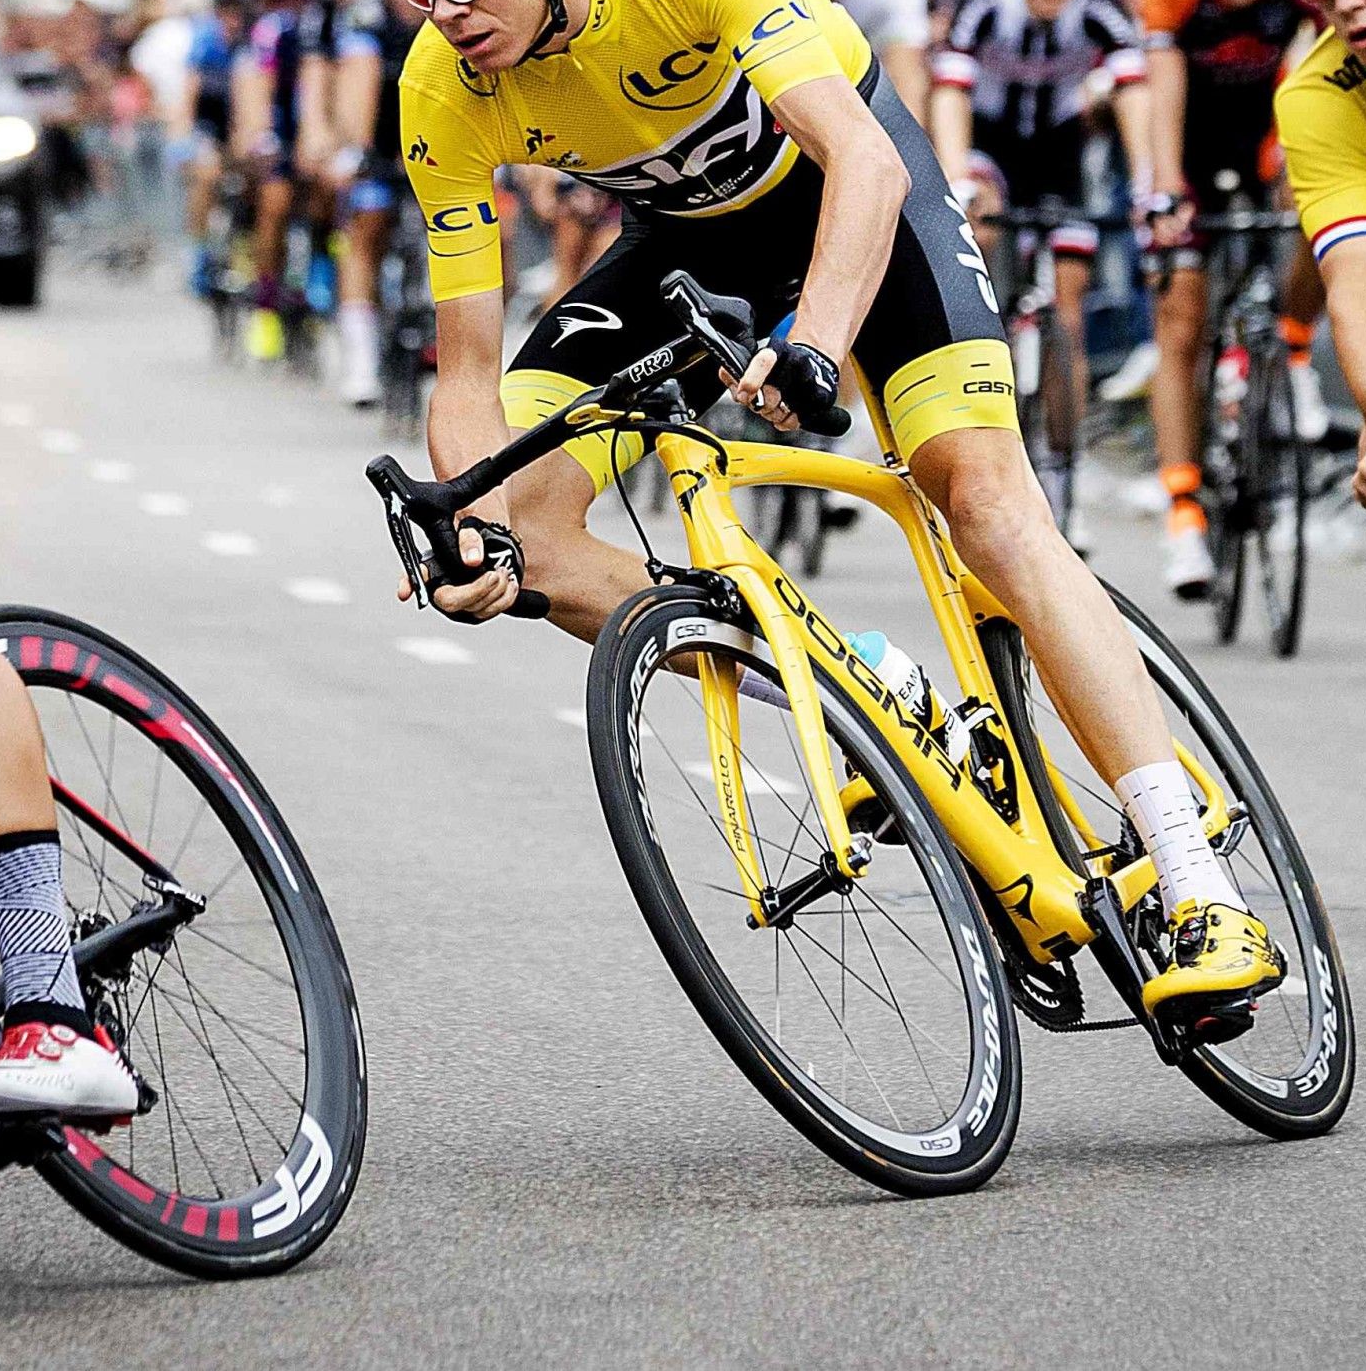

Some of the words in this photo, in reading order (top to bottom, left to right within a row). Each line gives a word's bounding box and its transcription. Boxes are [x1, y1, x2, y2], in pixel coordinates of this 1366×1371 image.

[732, 1, 811, 62] LCL
[626, 35, 722, 97] LCL
[628, 346, 675, 384] PRO
[963, 381, 1013, 396] cast
[718, 754, 748, 854] PINARELLO
